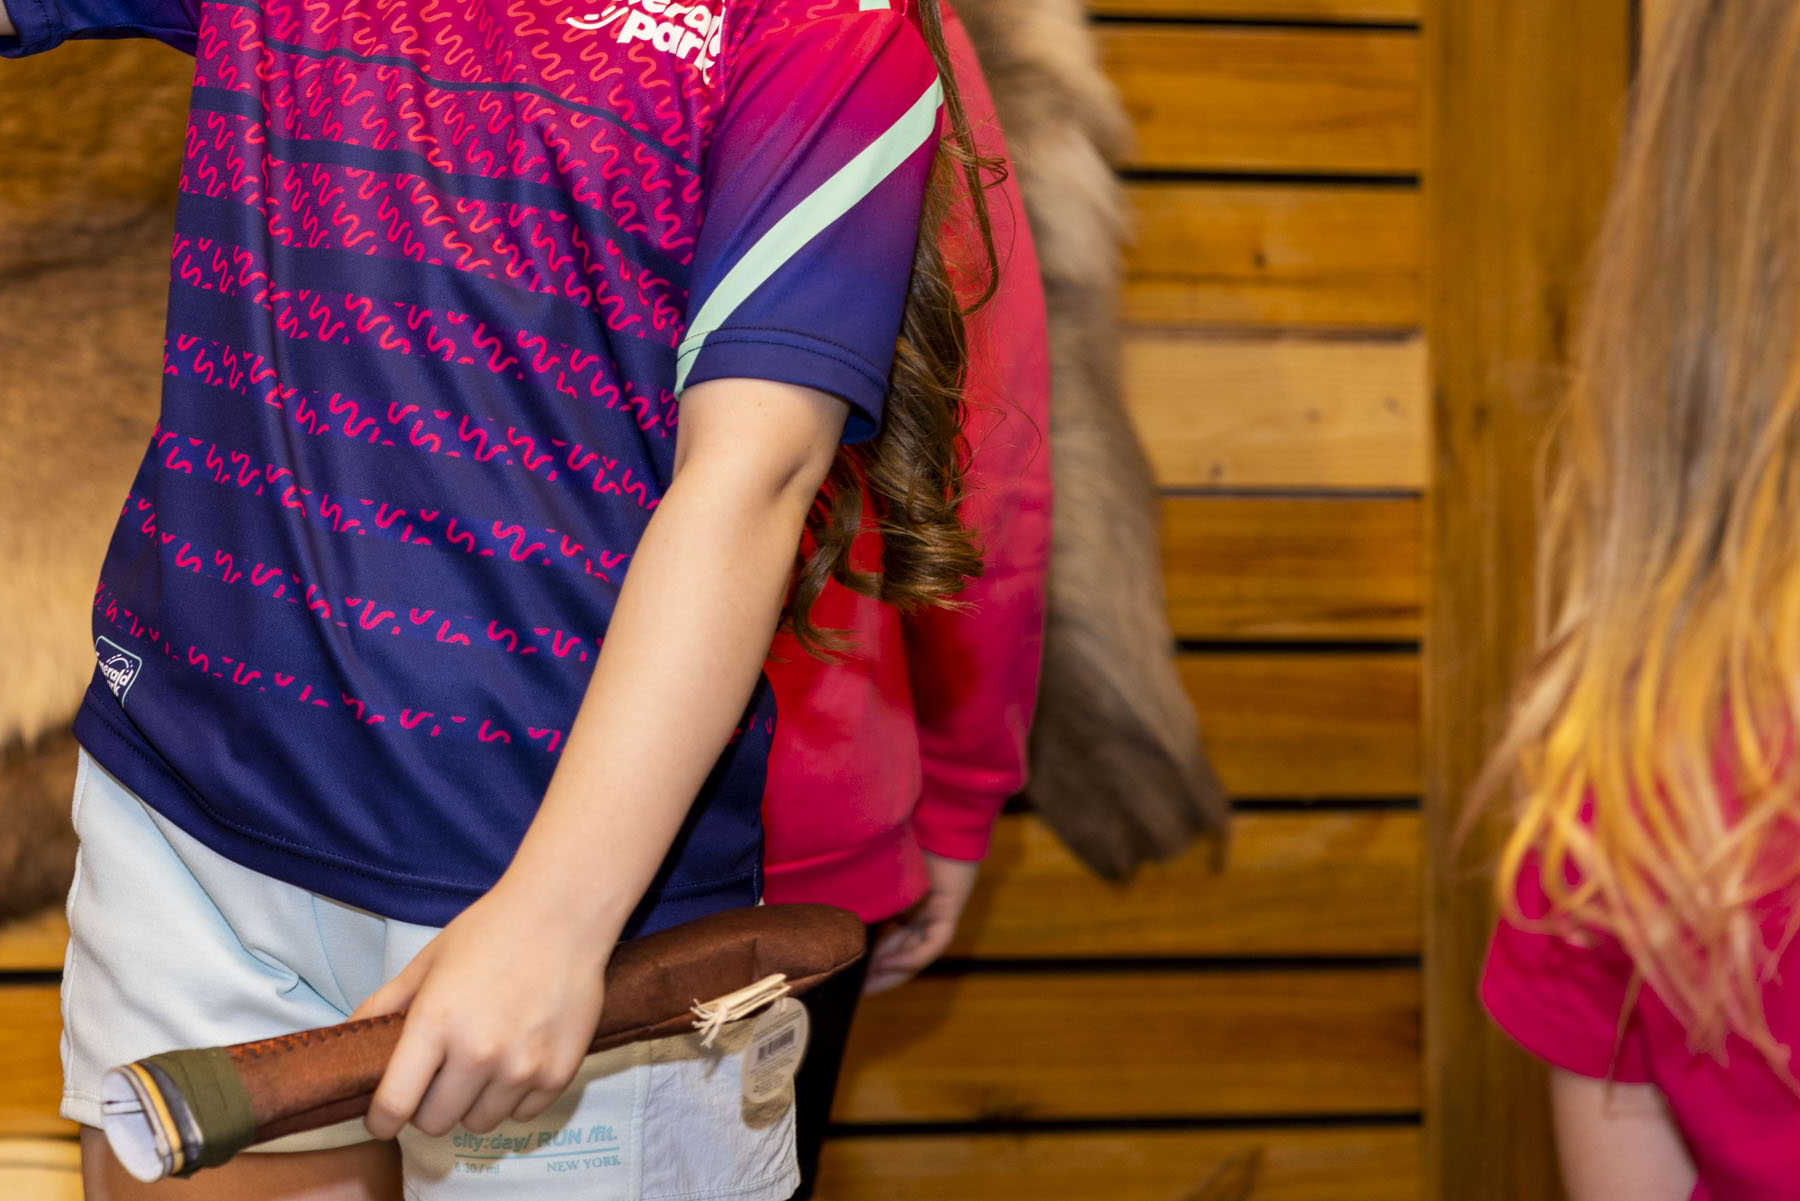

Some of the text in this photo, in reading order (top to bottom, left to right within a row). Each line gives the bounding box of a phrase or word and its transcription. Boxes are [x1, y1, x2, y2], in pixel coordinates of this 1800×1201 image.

[97, 658, 135, 687] erald
[537, 1128, 583, 1147] RUN
[546, 1155, 622, 1173] NEW YORK
